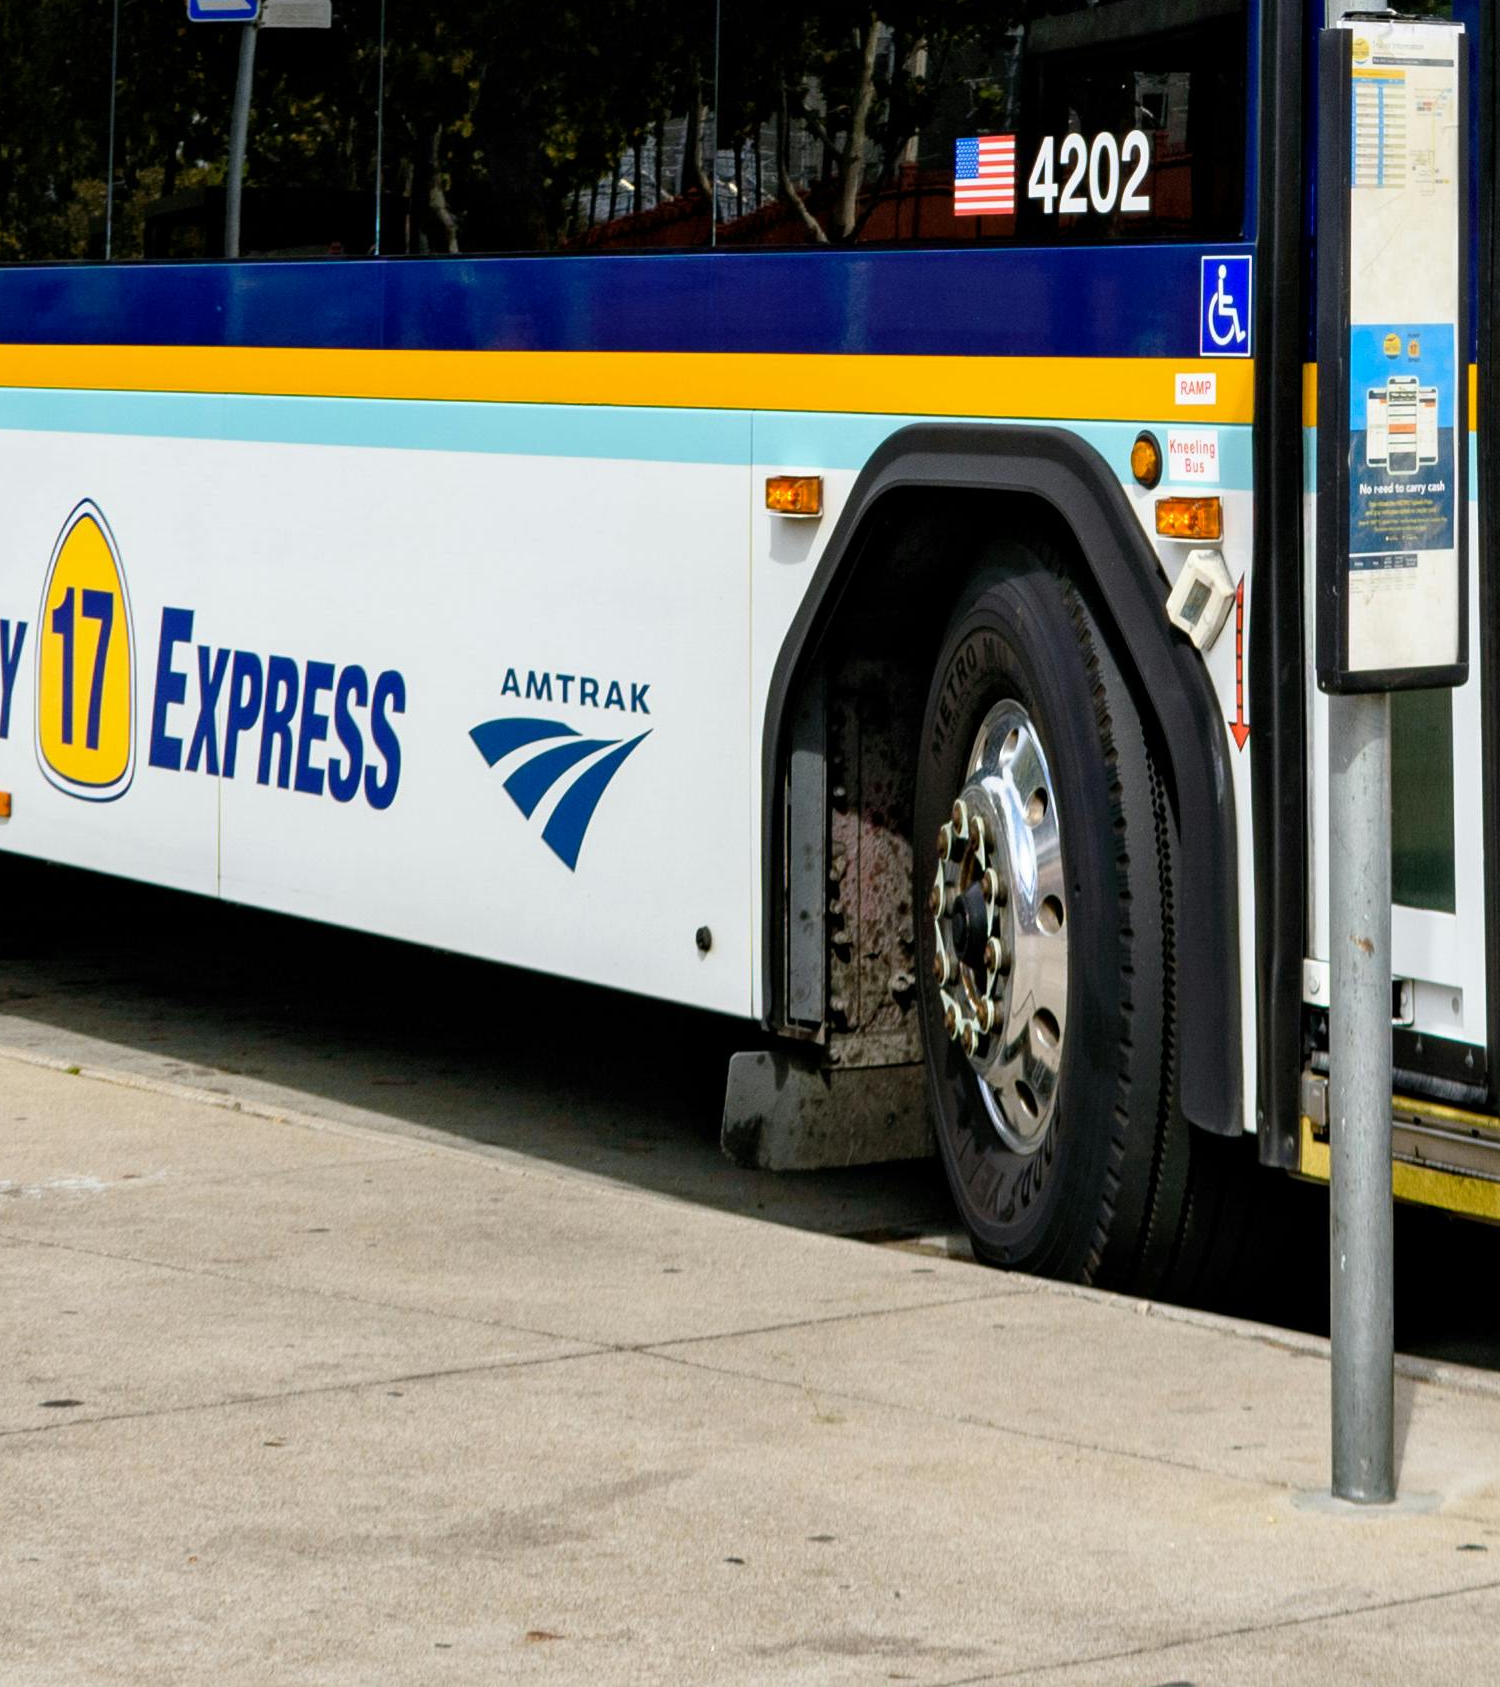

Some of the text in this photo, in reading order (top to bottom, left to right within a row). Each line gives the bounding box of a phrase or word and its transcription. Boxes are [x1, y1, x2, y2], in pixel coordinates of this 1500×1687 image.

[1028, 129, 1150, 214] 4202
[1180, 380, 1212, 396] RAMP
[1169, 438, 1216, 459] Kneeling
[1184, 457, 1205, 474] Bus
[1359, 480, 1445, 495] No need to carry cash
[49, 585, 115, 752] 17
[147, 606, 406, 811] EXPRESS
[500, 667, 652, 715] AMTRAK
